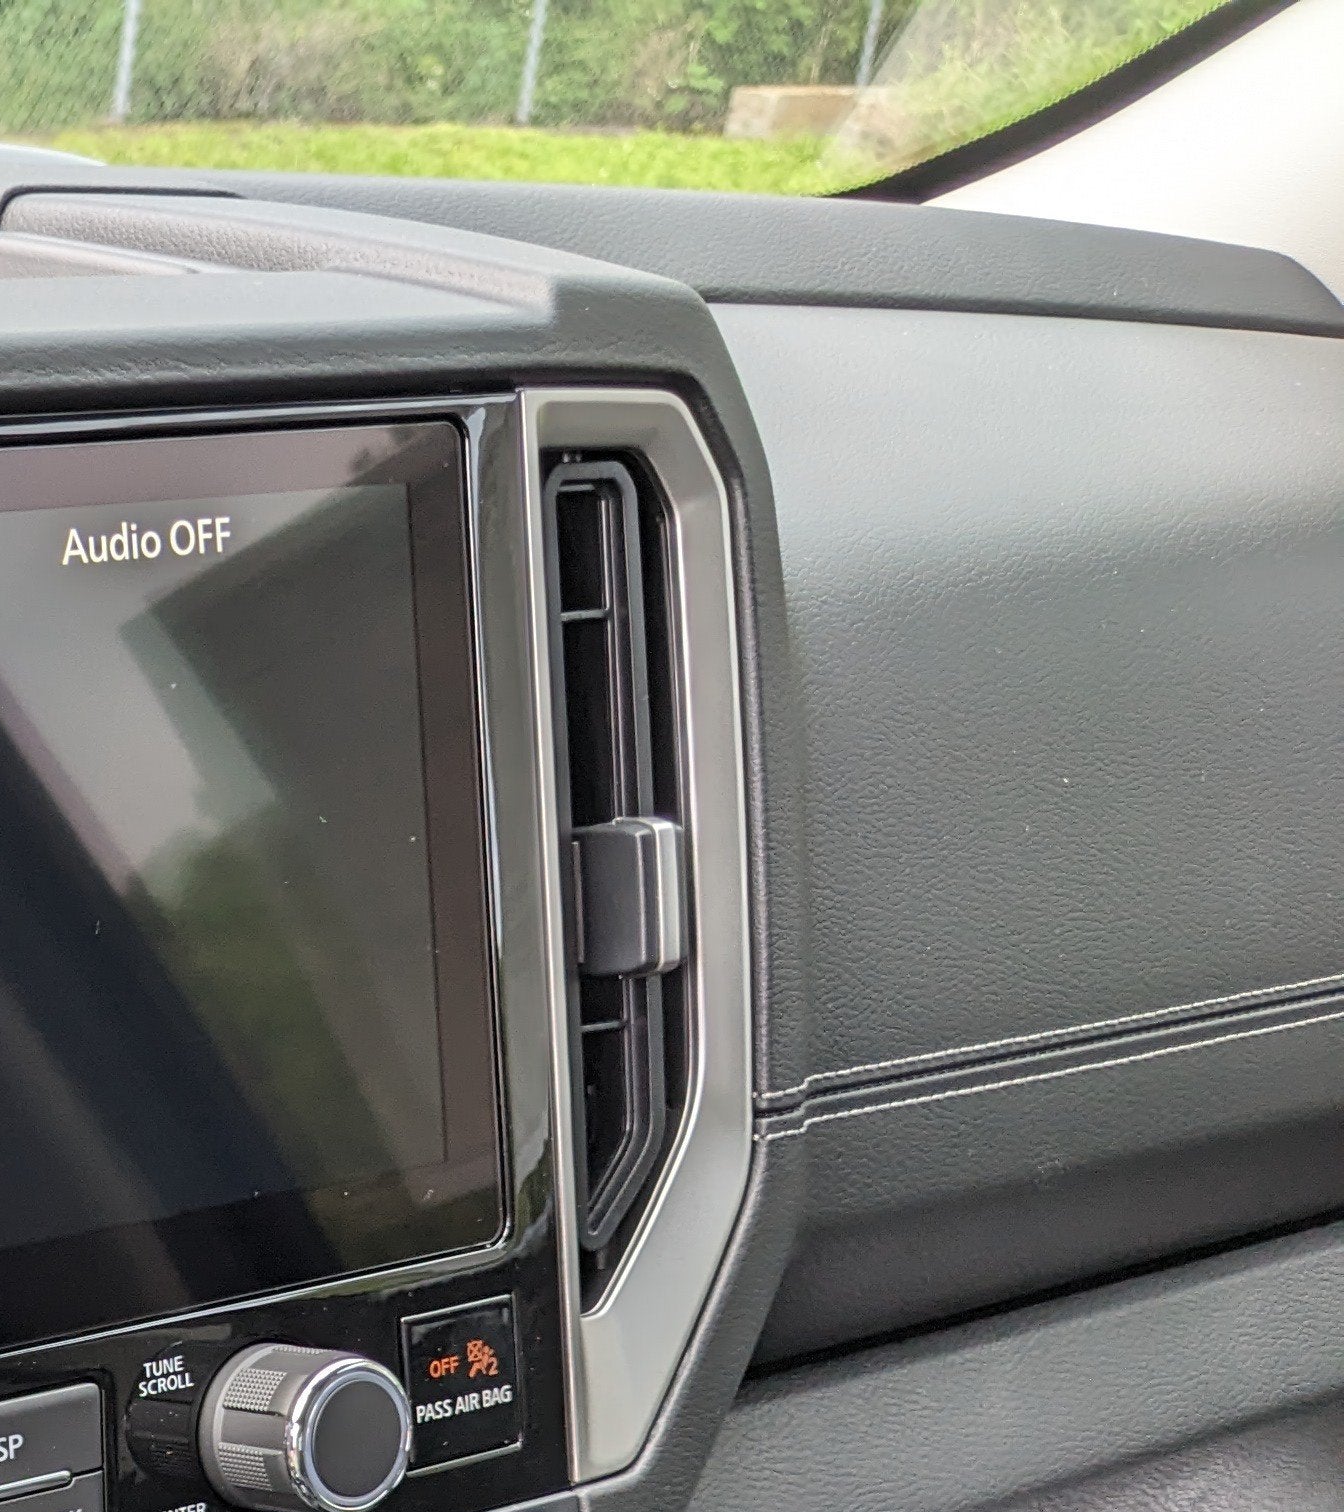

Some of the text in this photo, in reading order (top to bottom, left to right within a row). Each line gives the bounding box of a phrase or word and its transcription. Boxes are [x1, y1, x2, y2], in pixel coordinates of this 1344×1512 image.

[62, 517, 231, 566] Audio OFF
[142, 1355, 185, 1378] TUNE
[429, 1355, 459, 1379] OFF
[138, 1373, 194, 1397] SCROLL
[415, 1384, 513, 1424] PASS AIR BAG
